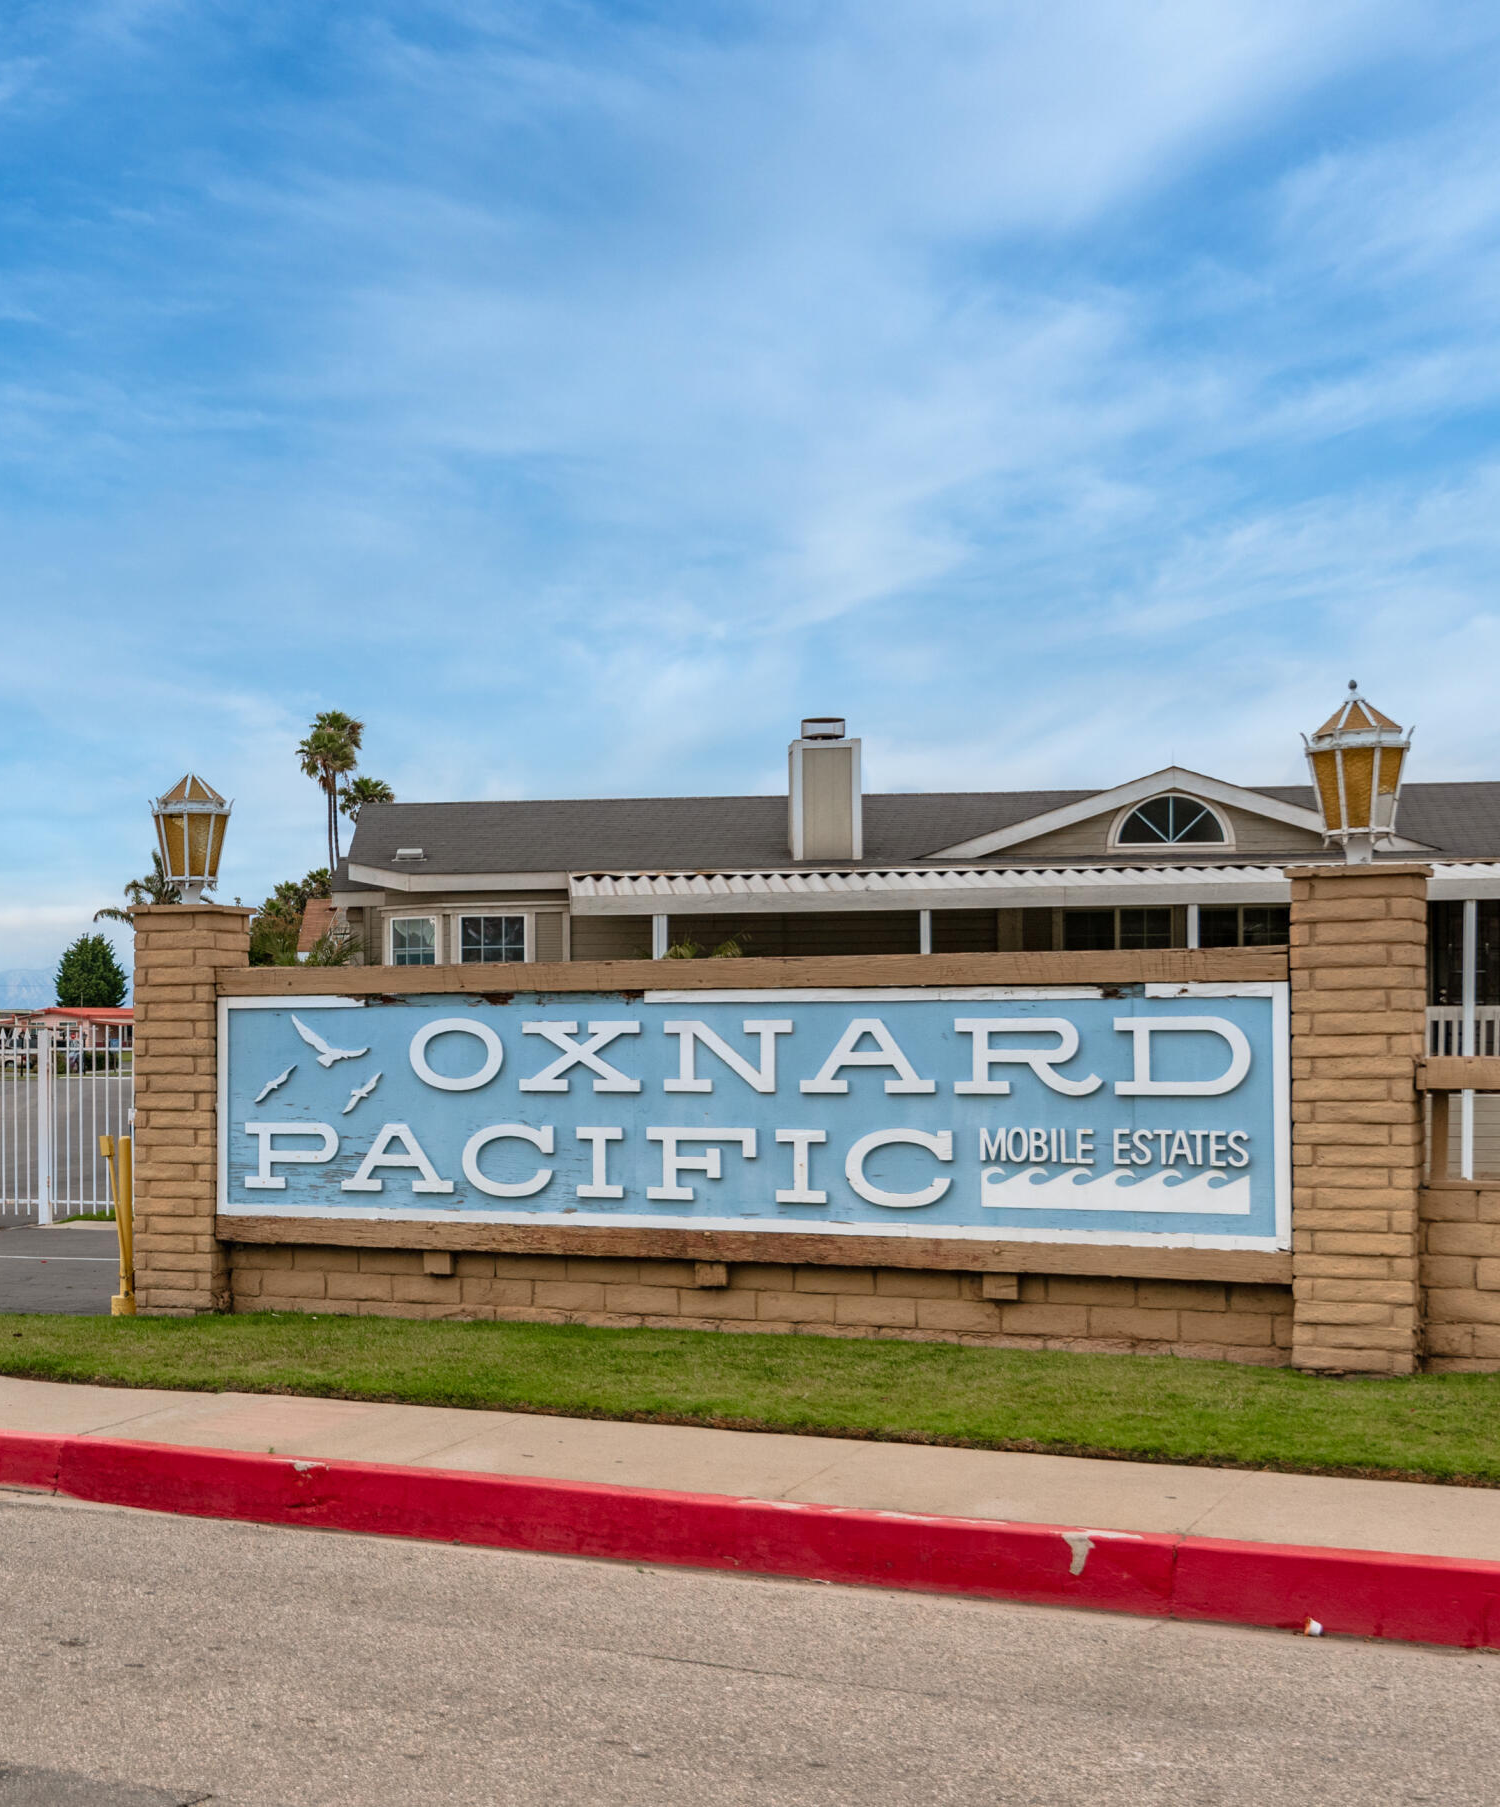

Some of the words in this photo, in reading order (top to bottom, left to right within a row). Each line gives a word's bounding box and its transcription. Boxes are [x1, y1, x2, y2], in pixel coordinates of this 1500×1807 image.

[408, 1015, 1255, 1098] OXNARD
[243, 1120, 956, 1209] PACIFIC
[978, 1126, 1095, 1165] MOBILE
[1112, 1128, 1251, 1168] ESTATES
